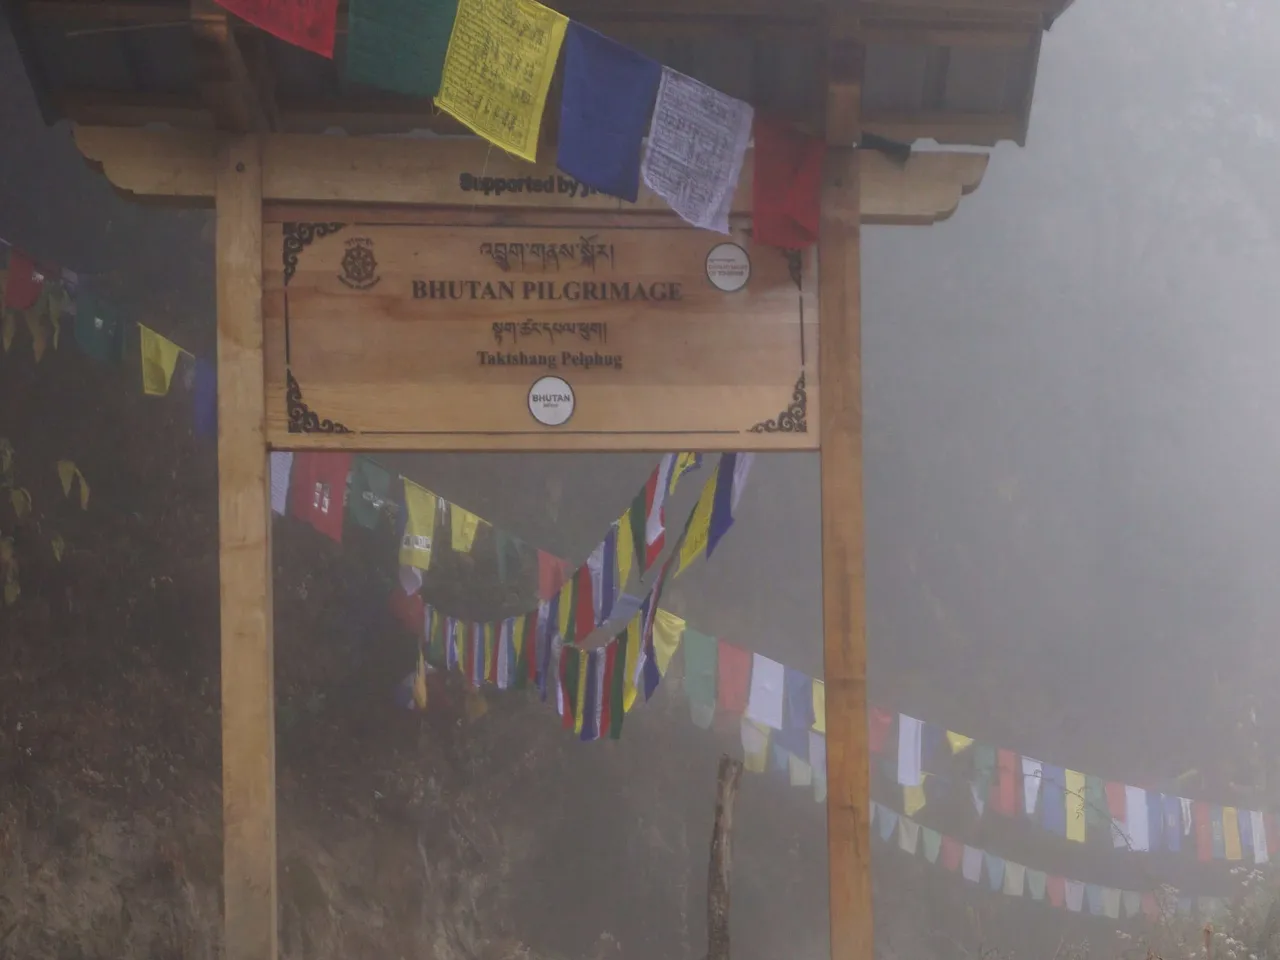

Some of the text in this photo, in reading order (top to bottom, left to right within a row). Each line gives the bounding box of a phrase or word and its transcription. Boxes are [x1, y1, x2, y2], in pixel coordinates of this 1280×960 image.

[459, 173, 555, 196] Supported
[557, 175, 579, 198] by
[412, 280, 683, 301] BHUTAN PILGRIMAGE
[476, 351, 623, 370] Taktshang Pelphug
[532, 394, 570, 402] BHUTAN
